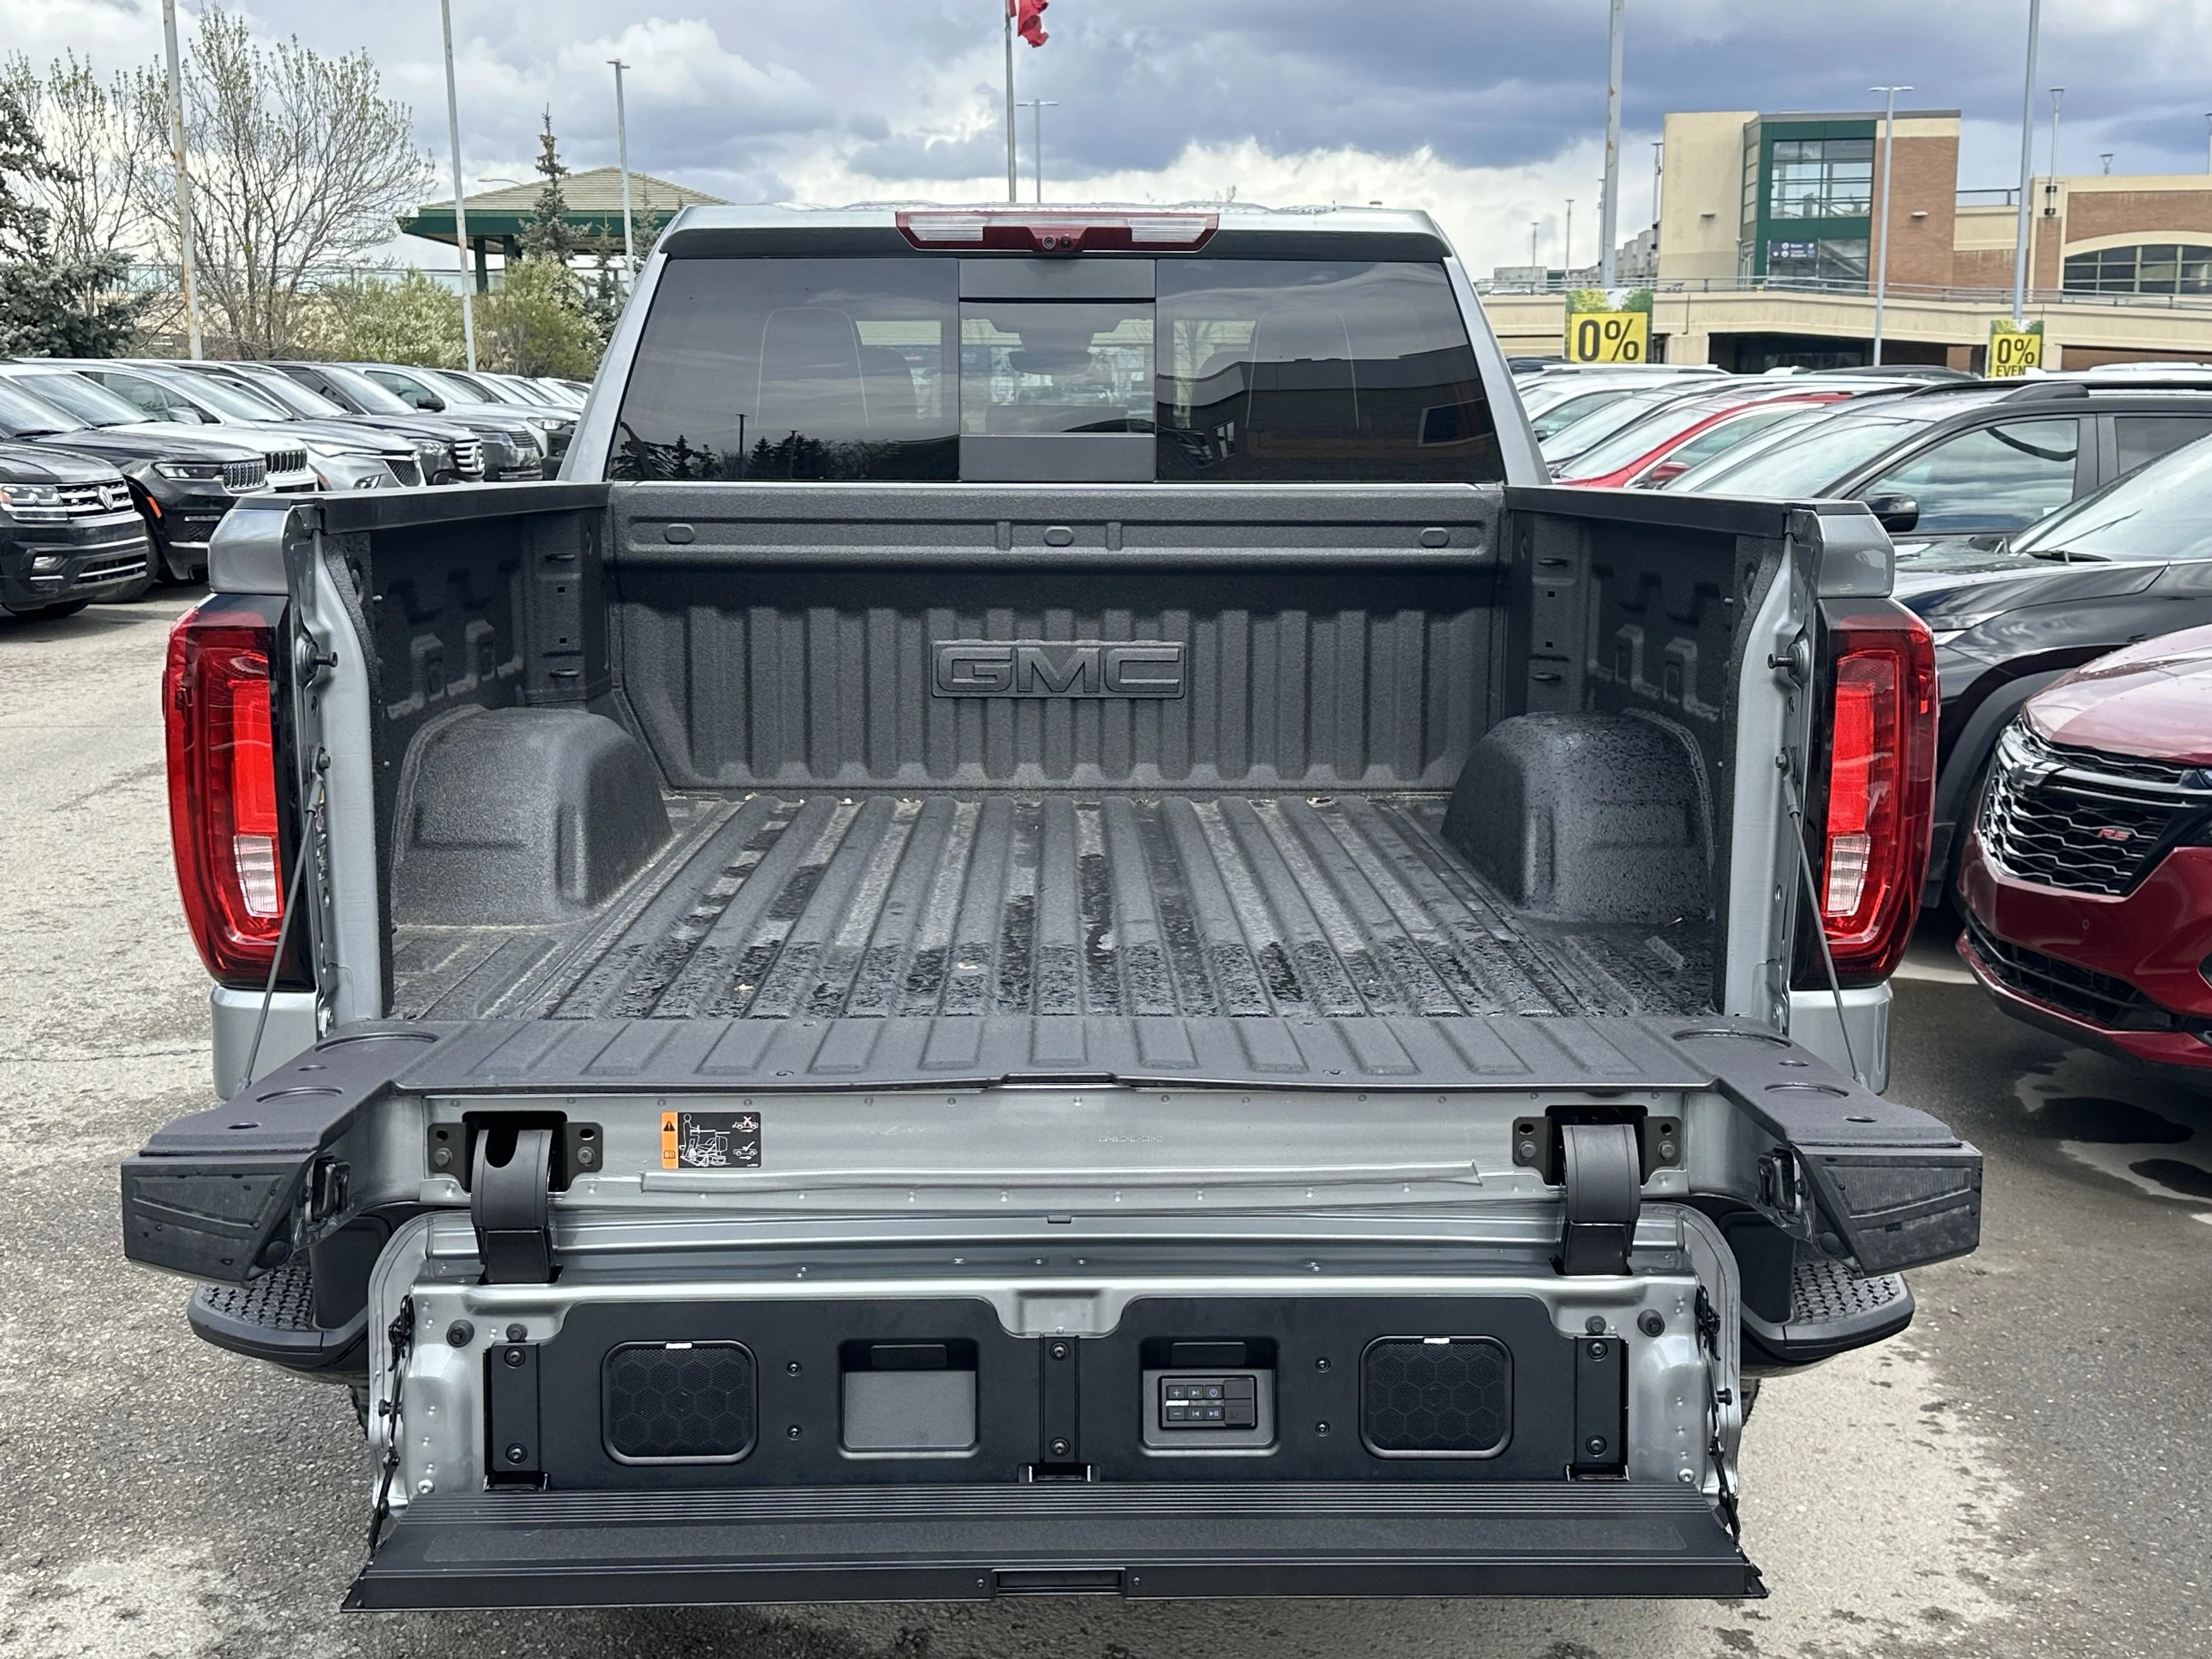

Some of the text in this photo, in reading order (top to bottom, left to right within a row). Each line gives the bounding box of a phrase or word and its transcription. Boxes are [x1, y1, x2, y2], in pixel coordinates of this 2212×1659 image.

[1579, 319, 1639, 362] 0%
[1997, 338, 2034, 364] 0%
[1996, 365, 2033, 377] EVEN
[938, 647, 1180, 693] GMC
[2097, 829, 2130, 842] RS
